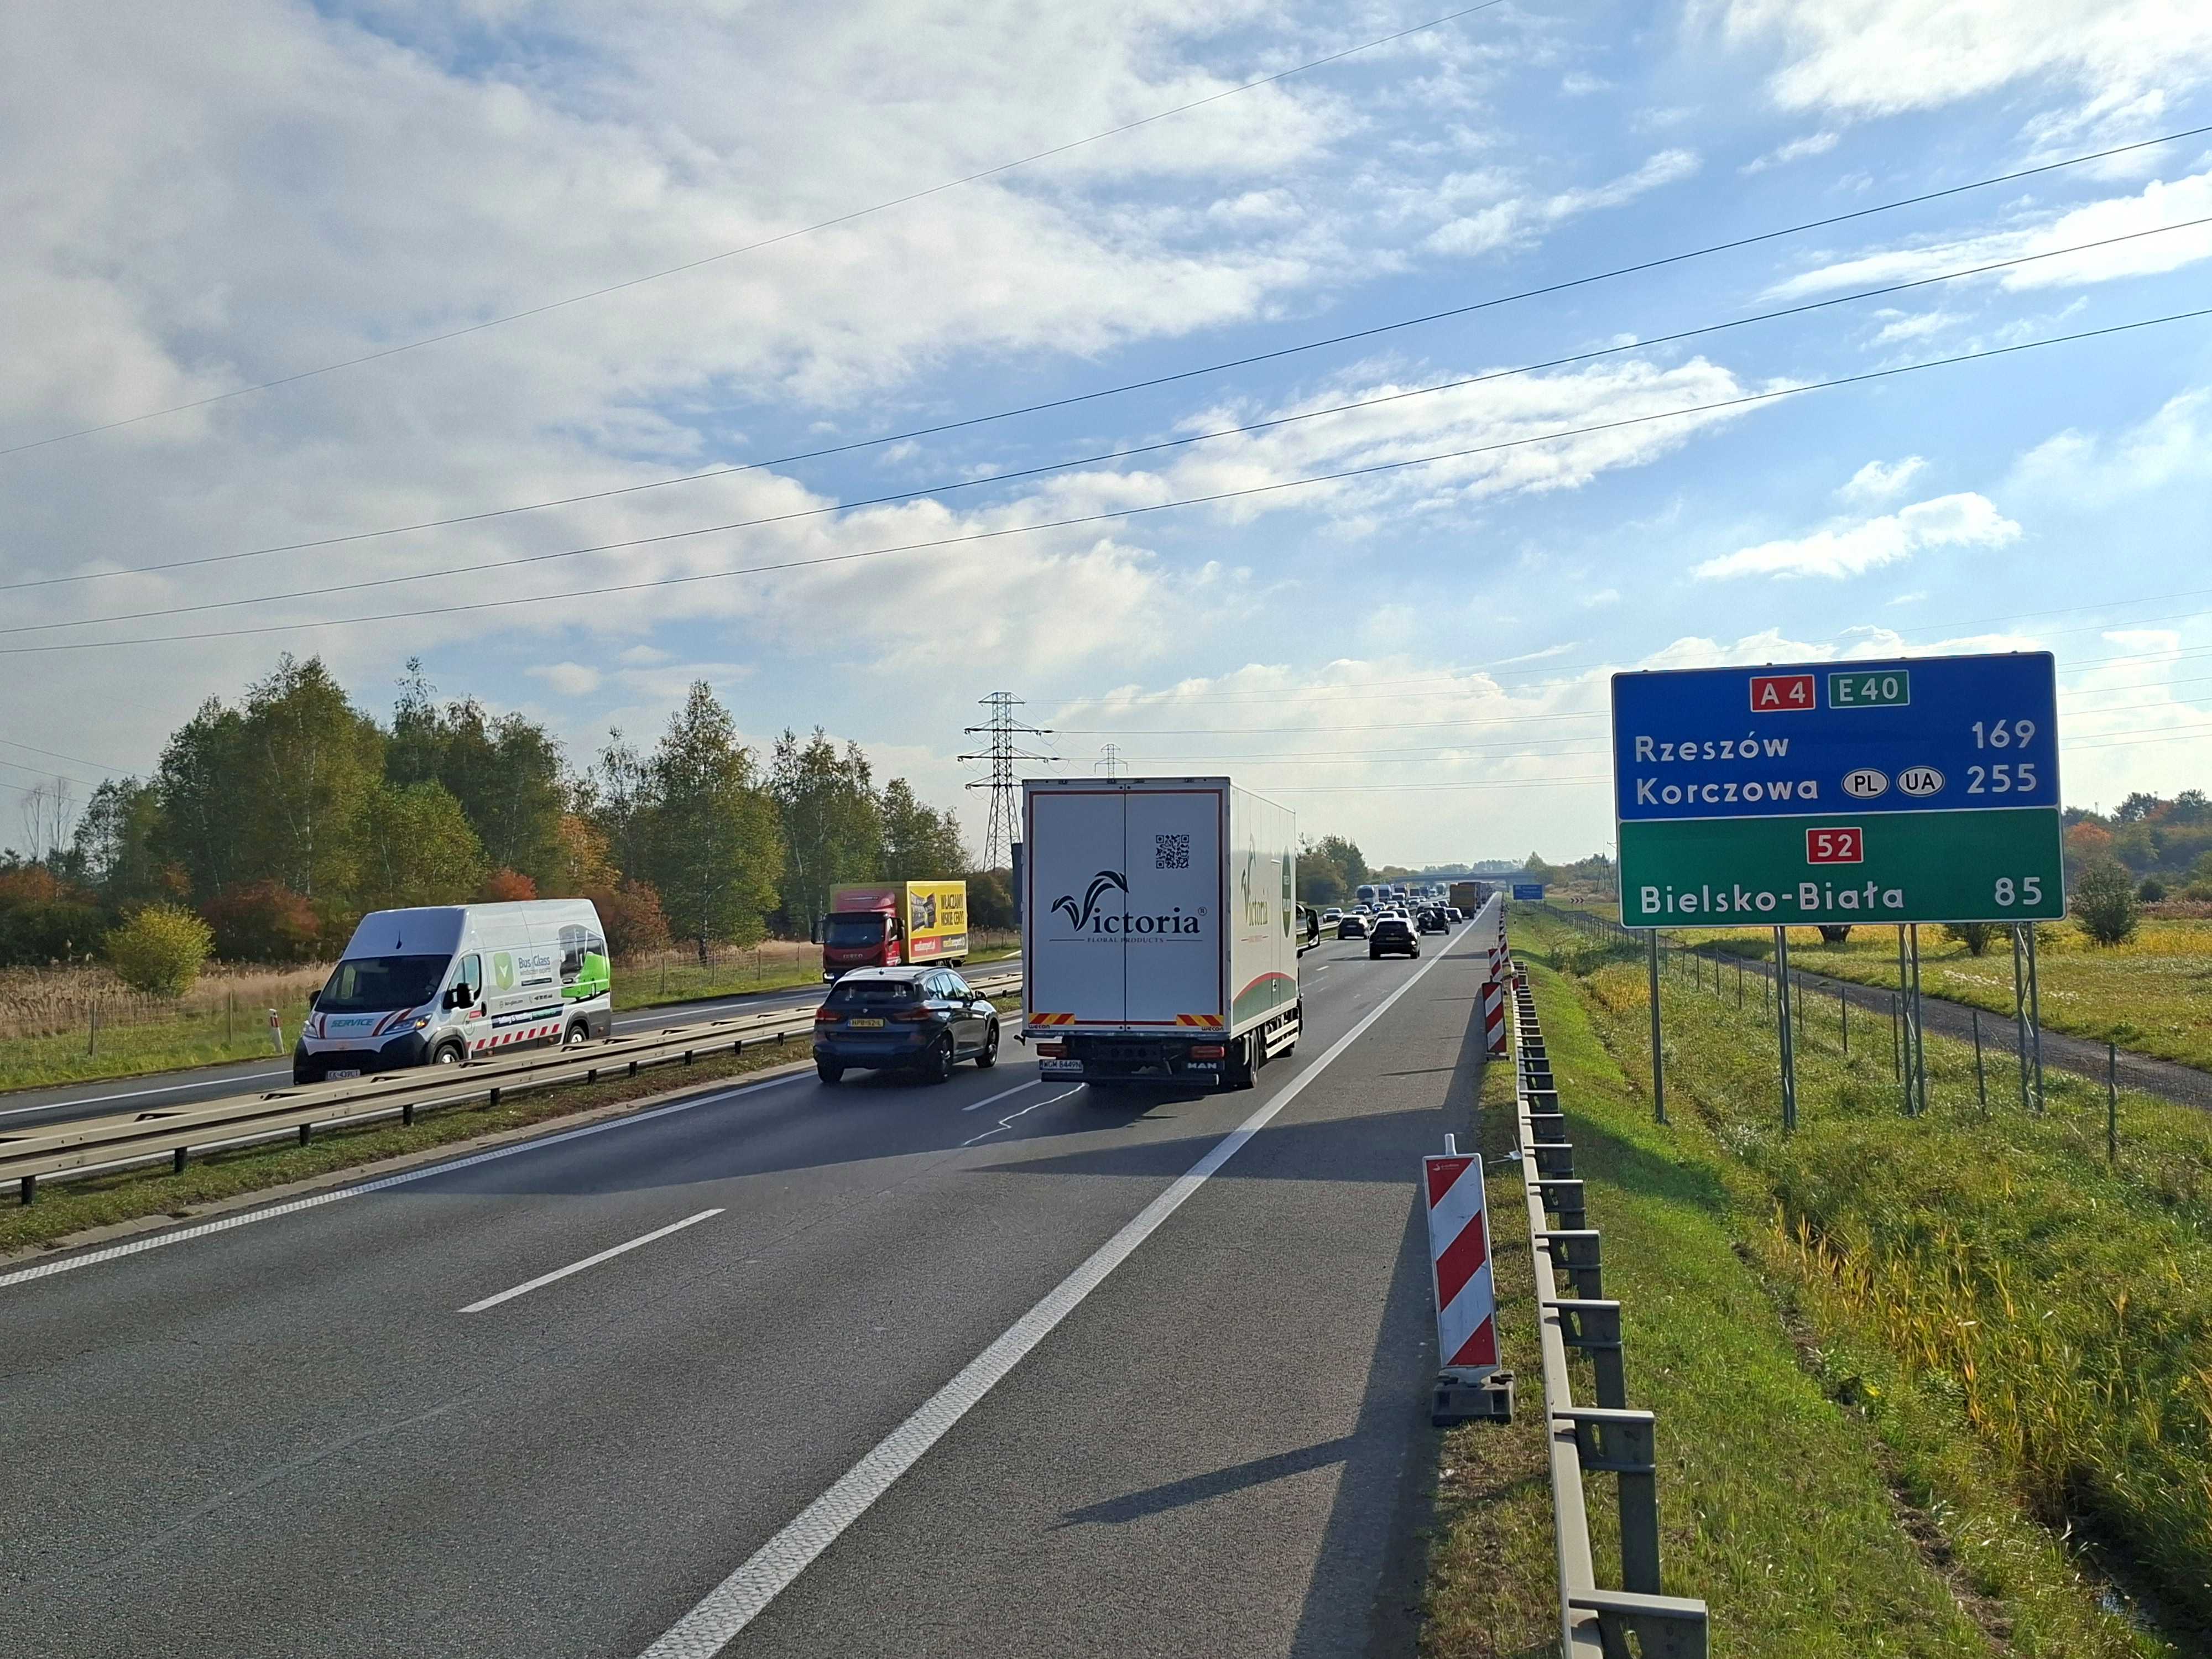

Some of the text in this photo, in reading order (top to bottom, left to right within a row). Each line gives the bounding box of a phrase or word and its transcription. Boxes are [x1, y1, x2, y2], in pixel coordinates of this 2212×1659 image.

[1636, 720, 2035, 761] Rzeszów 169
[1855, 775, 1877, 792] PL
[1906, 773, 1935, 790] UA
[1968, 764, 2036, 793] 255
[1637, 778, 1818, 805] Korczowa
[1818, 834, 1852, 857] 52
[1641, 877, 2042, 913] Bielsko-Biała 85
[518, 954, 550, 968] Bus Glass
[331, 1019, 375, 1027] SERVICE
